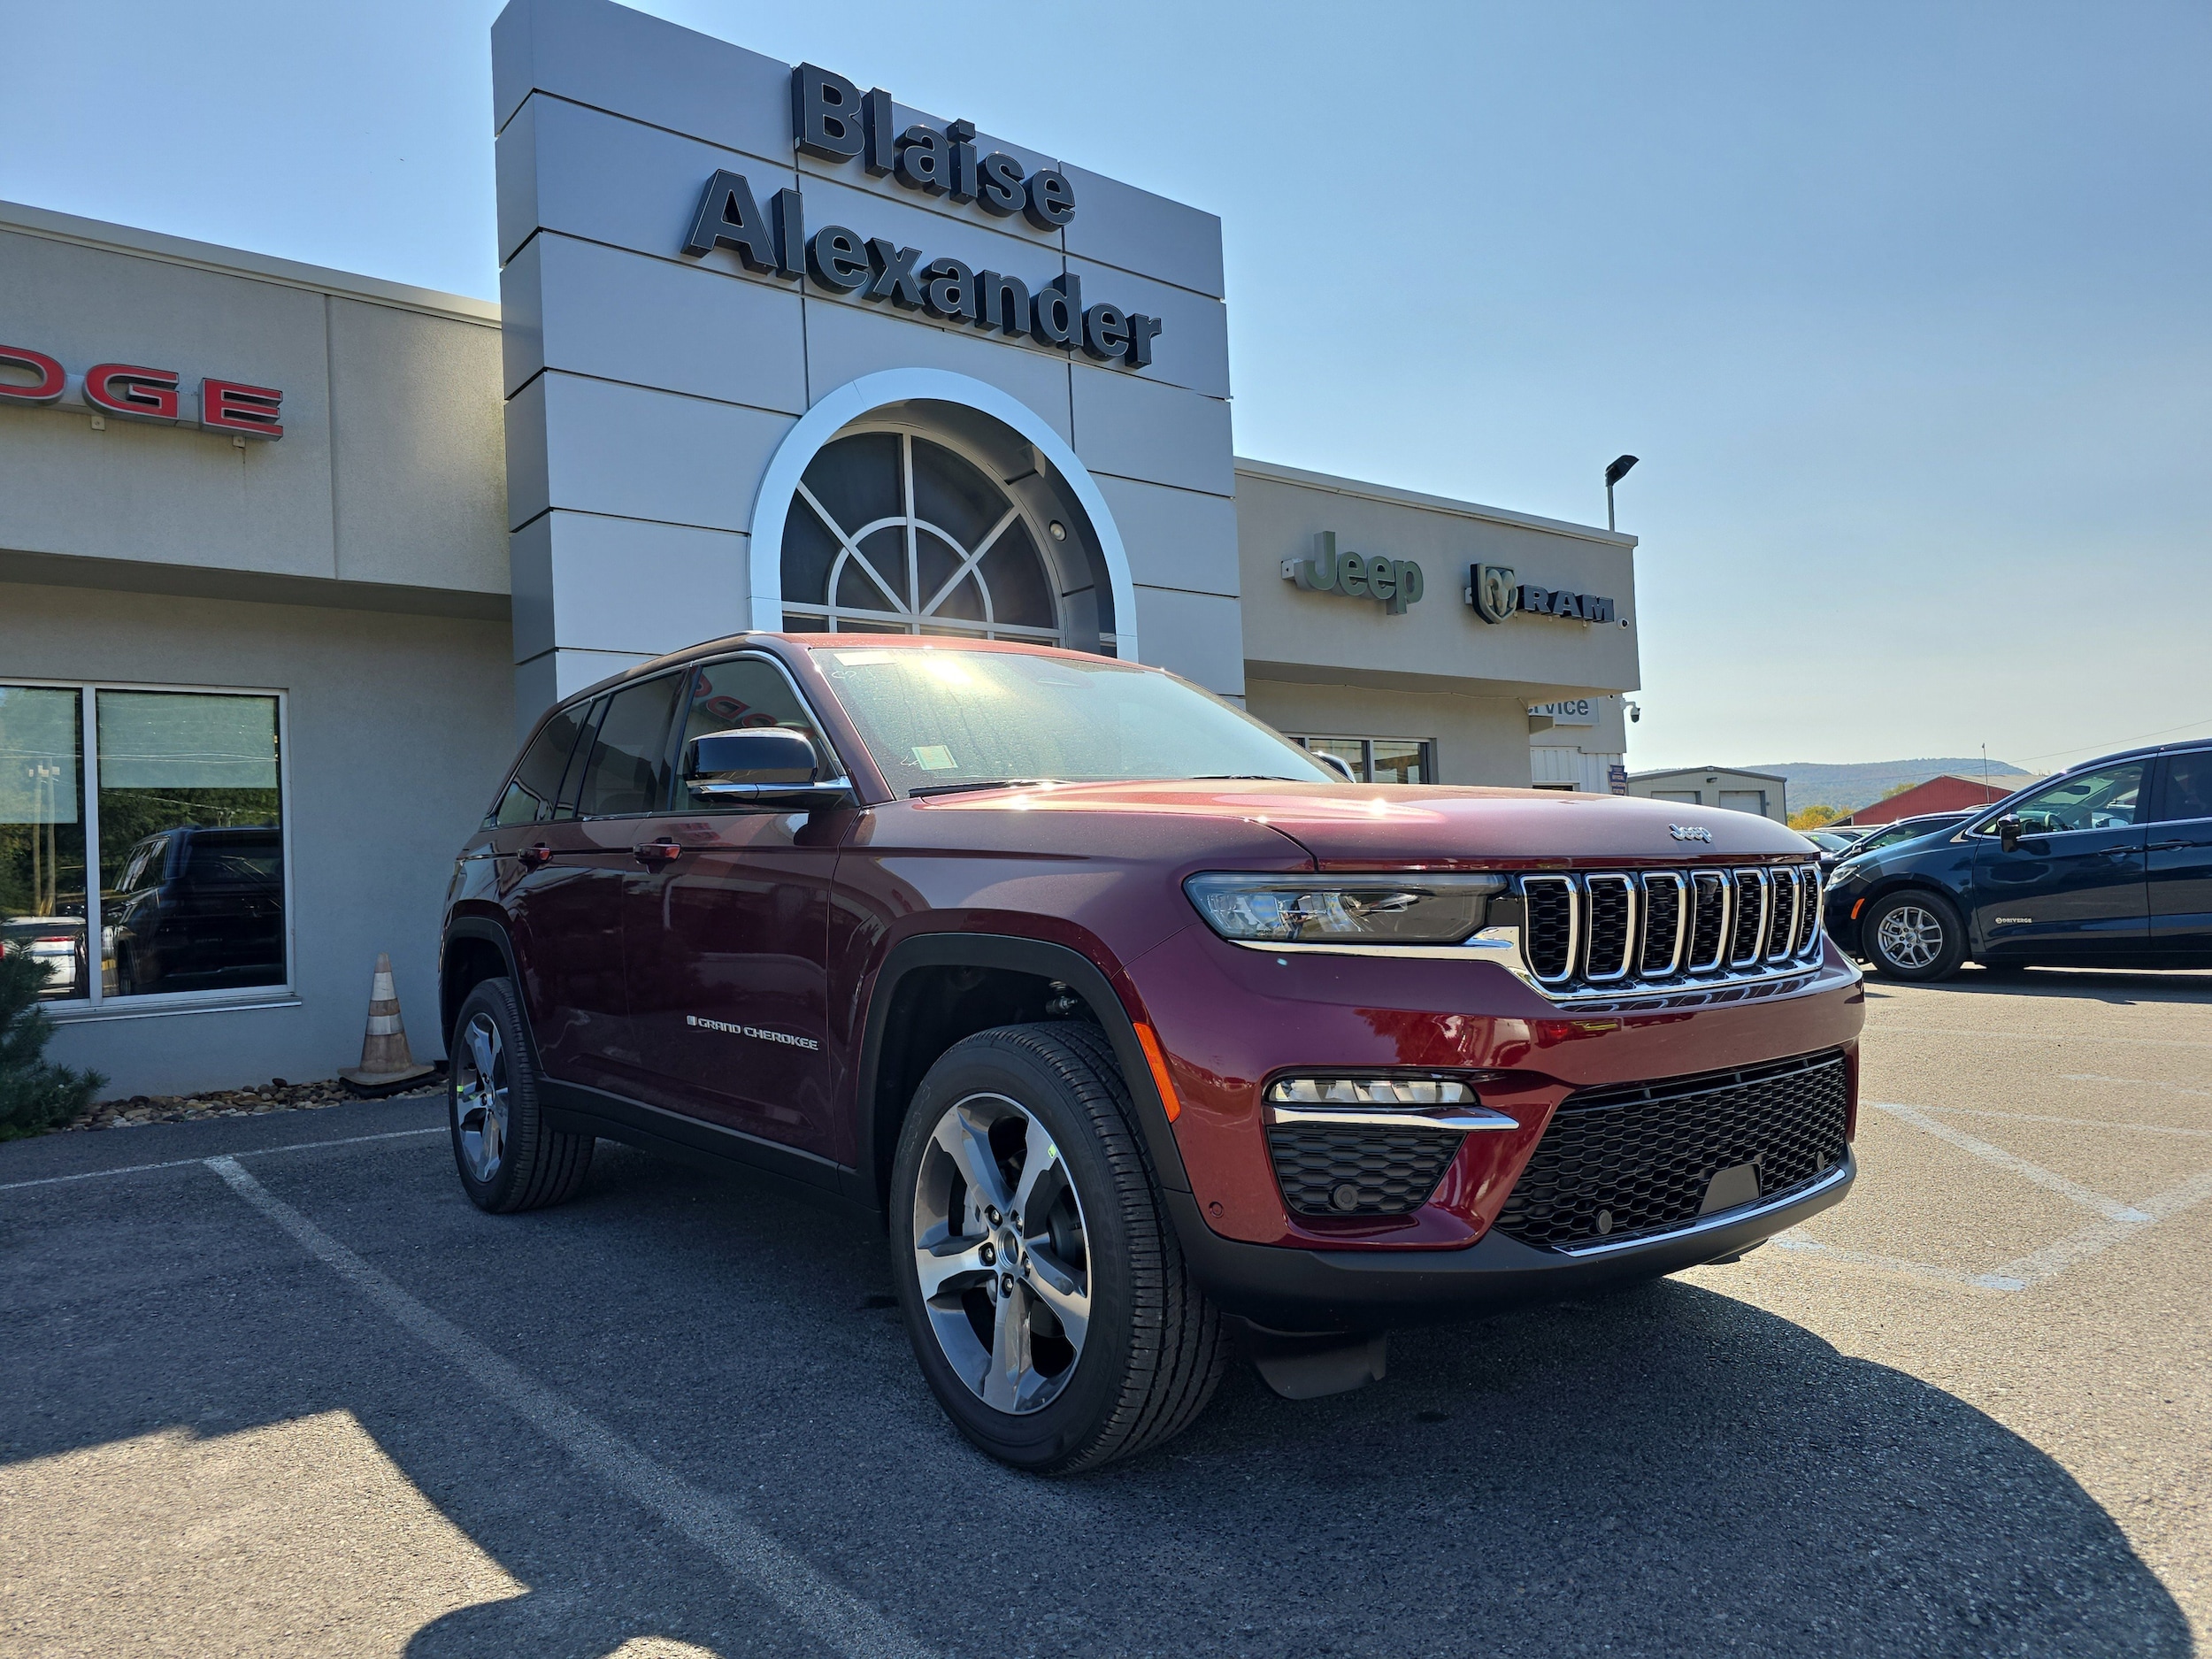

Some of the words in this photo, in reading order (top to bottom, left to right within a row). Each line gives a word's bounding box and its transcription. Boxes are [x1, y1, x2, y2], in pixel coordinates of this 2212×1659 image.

[792, 62, 1076, 232] Blaise
[680, 168, 1162, 369] Alexander
[1294, 531, 1424, 616] Jeep
[1516, 584, 1615, 623] RAM
[1669, 823, 1713, 843] Jeep
[697, 1018, 741, 1034] GRAND
[743, 1026, 819, 1051] CHEROKEE
